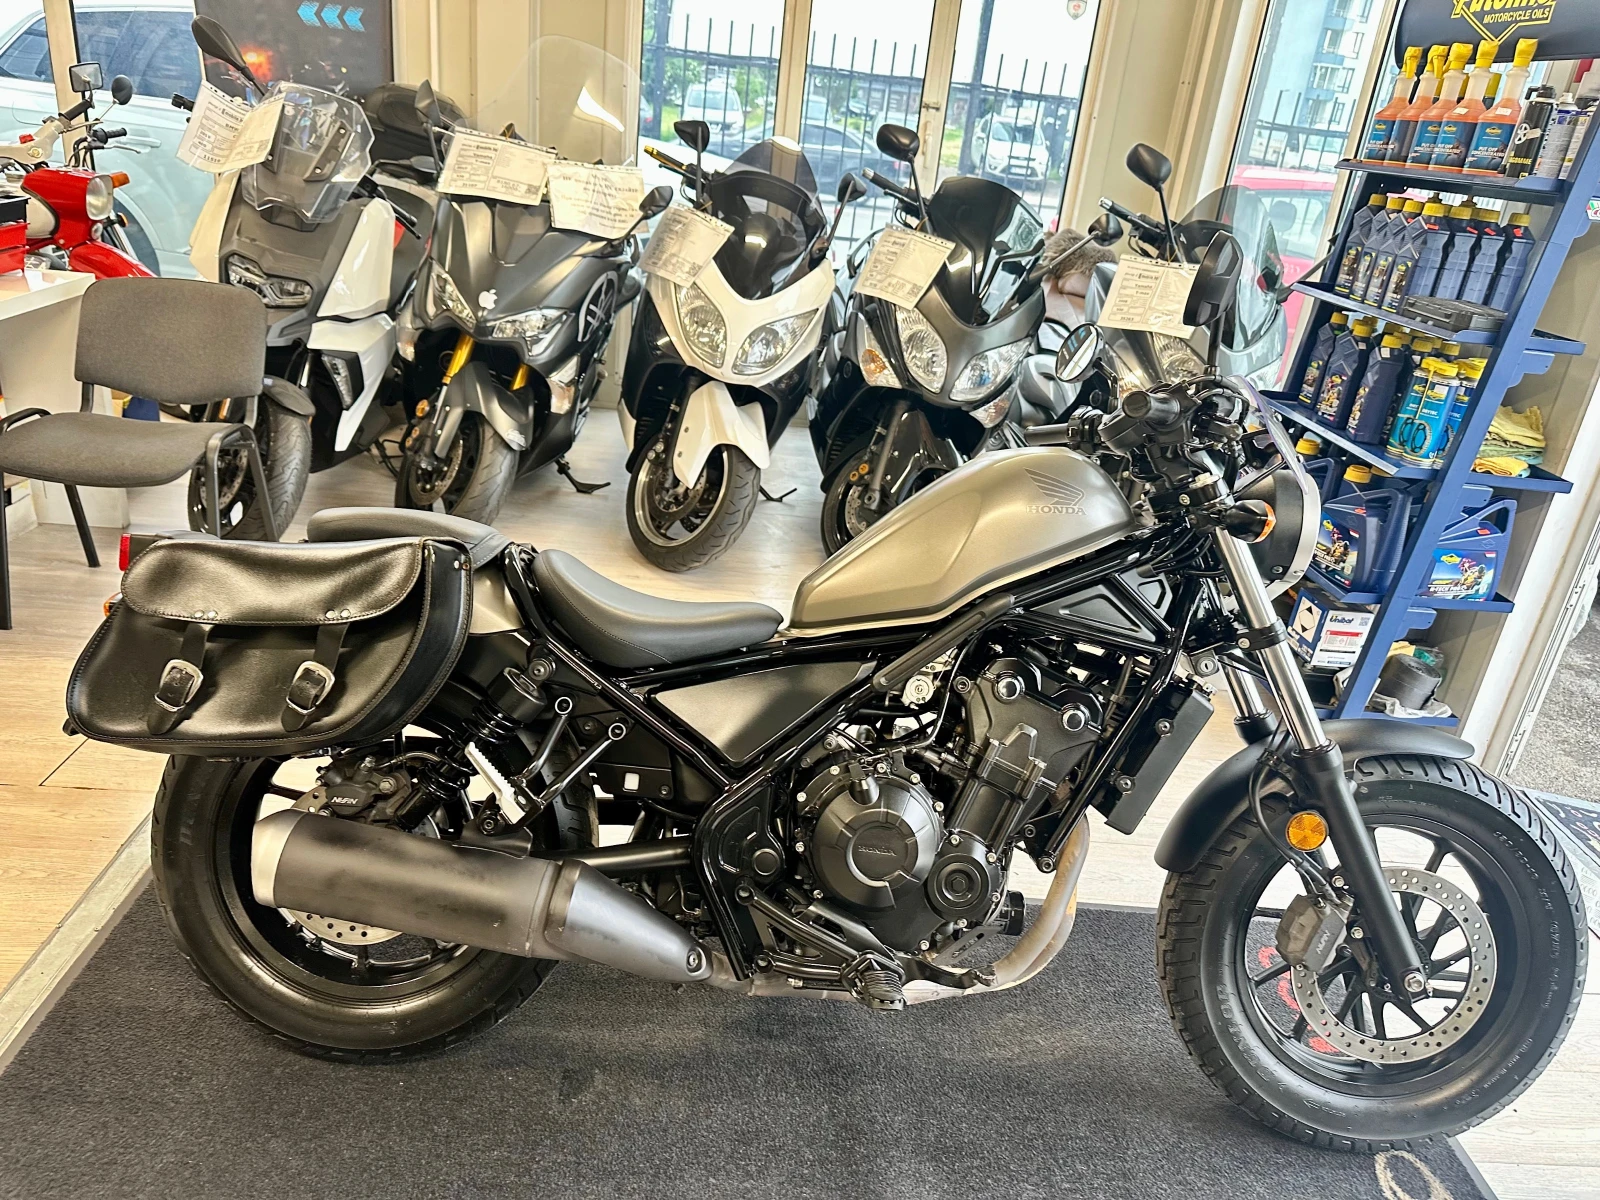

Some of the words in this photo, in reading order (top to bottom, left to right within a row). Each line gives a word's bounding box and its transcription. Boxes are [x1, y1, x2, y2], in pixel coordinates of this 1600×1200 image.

[1482, 9, 1532, 24] MOTORCYCLE
[1531, 7, 1550, 19] OILS
[1026, 505, 1087, 516] HONDA
[1216, 983, 1277, 1082] DUNLOP
